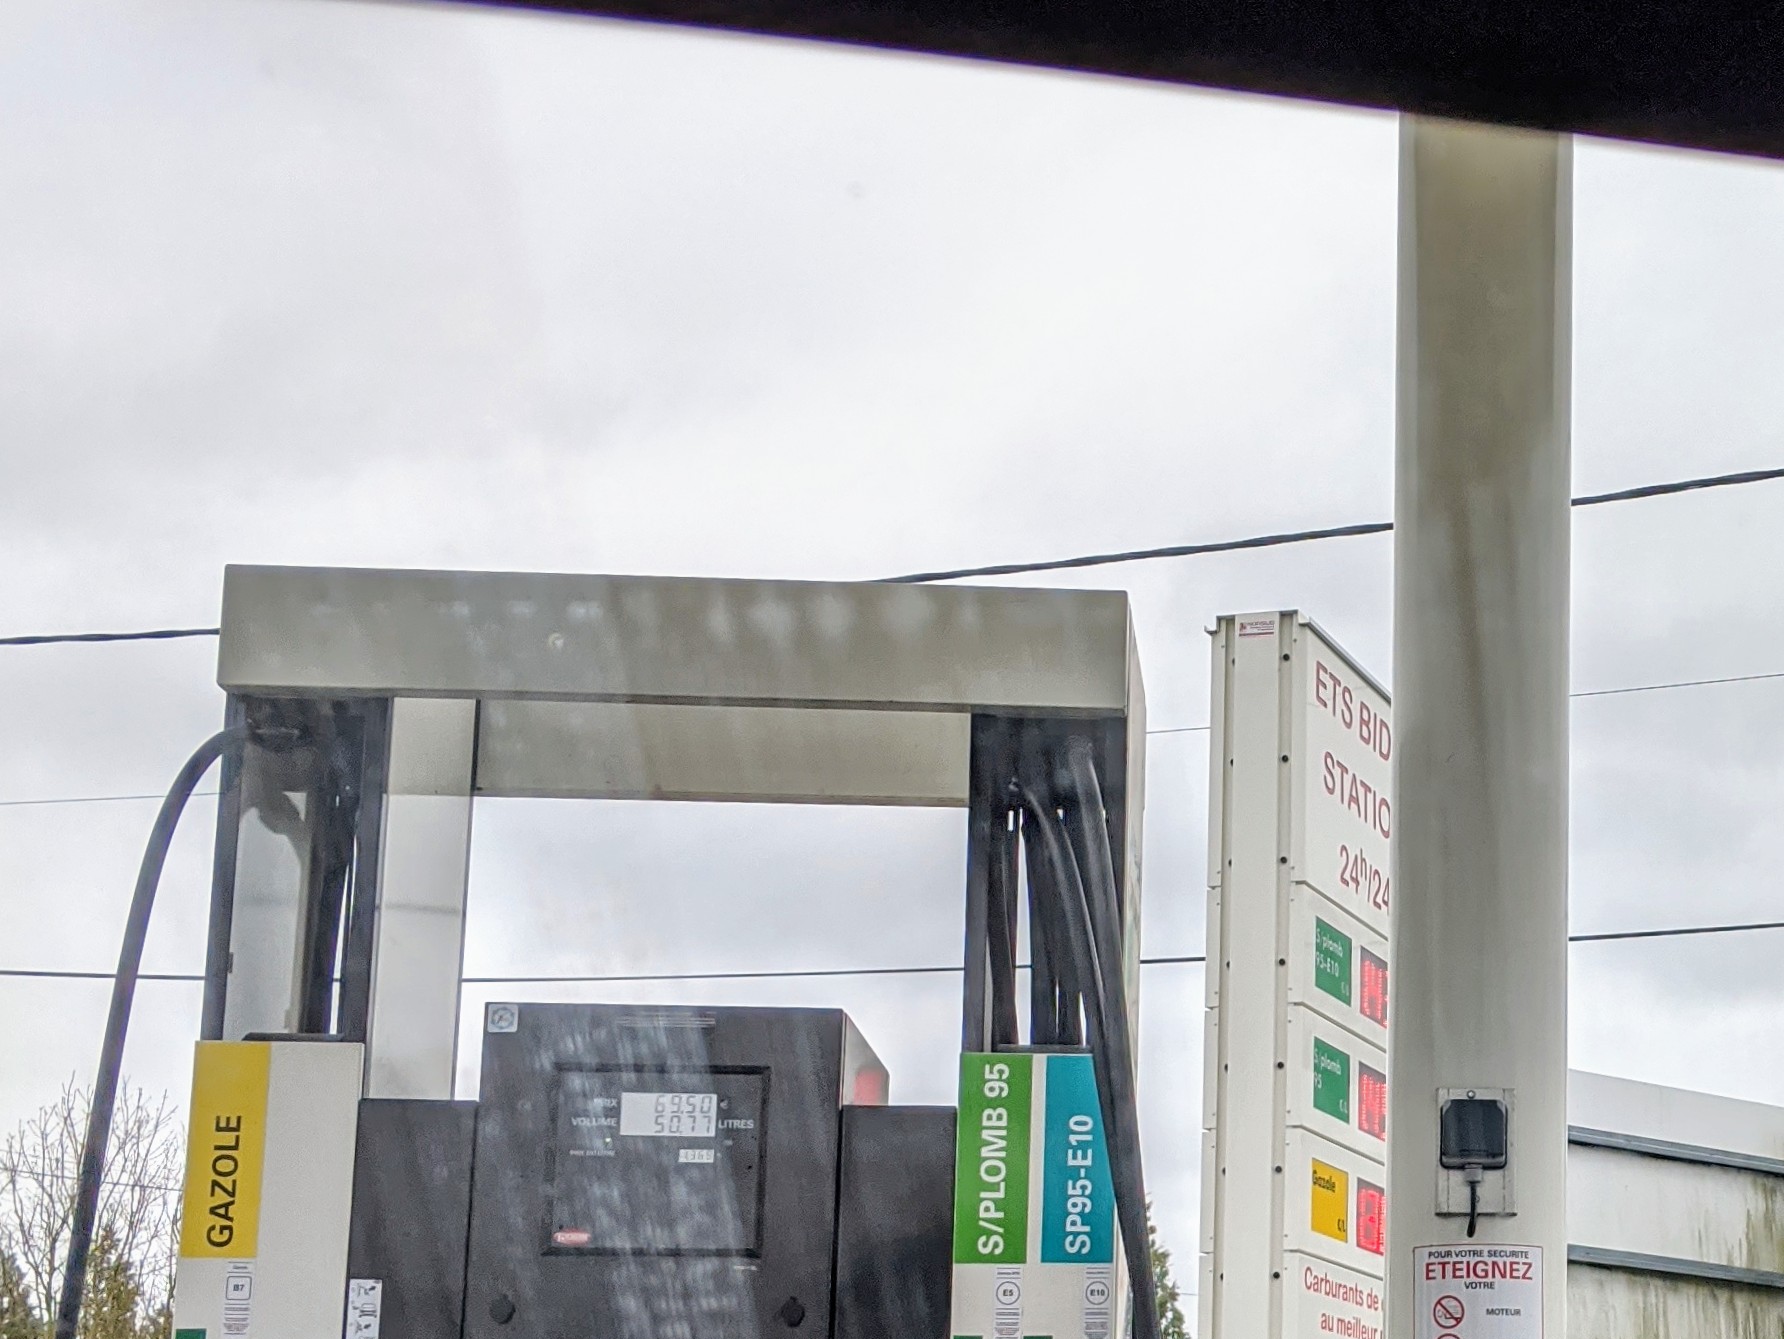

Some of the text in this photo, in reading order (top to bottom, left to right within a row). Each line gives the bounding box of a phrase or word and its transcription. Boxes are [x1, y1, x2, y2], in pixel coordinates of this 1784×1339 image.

[1316, 660, 1353, 730] ETS
[984, 1063, 1010, 1098] 95
[655, 1095, 712, 1114] 69.50
[571, 1115, 754, 1133] VOLUME 50.77 LITRES
[206, 1115, 242, 1248] GAZOLE
[977, 1106, 1009, 1256] S/PLOMB
[1064, 1114, 1094, 1255] SP95-E10
[1428, 1249, 1529, 1259] POUR VOTRE SECURITE
[1425, 1260, 1533, 1281] ETEIGNEZ
[1002, 1288, 1014, 1297] E5
[1090, 1288, 1106, 1297] E10
[1304, 1266, 1364, 1307] Carburants
[1366, 1287, 1379, 1312] de
[1464, 1281, 1495, 1290] VOTRE
[1320, 1312, 1334, 1333] au
[1486, 1308, 1521, 1316] MOTEUR
